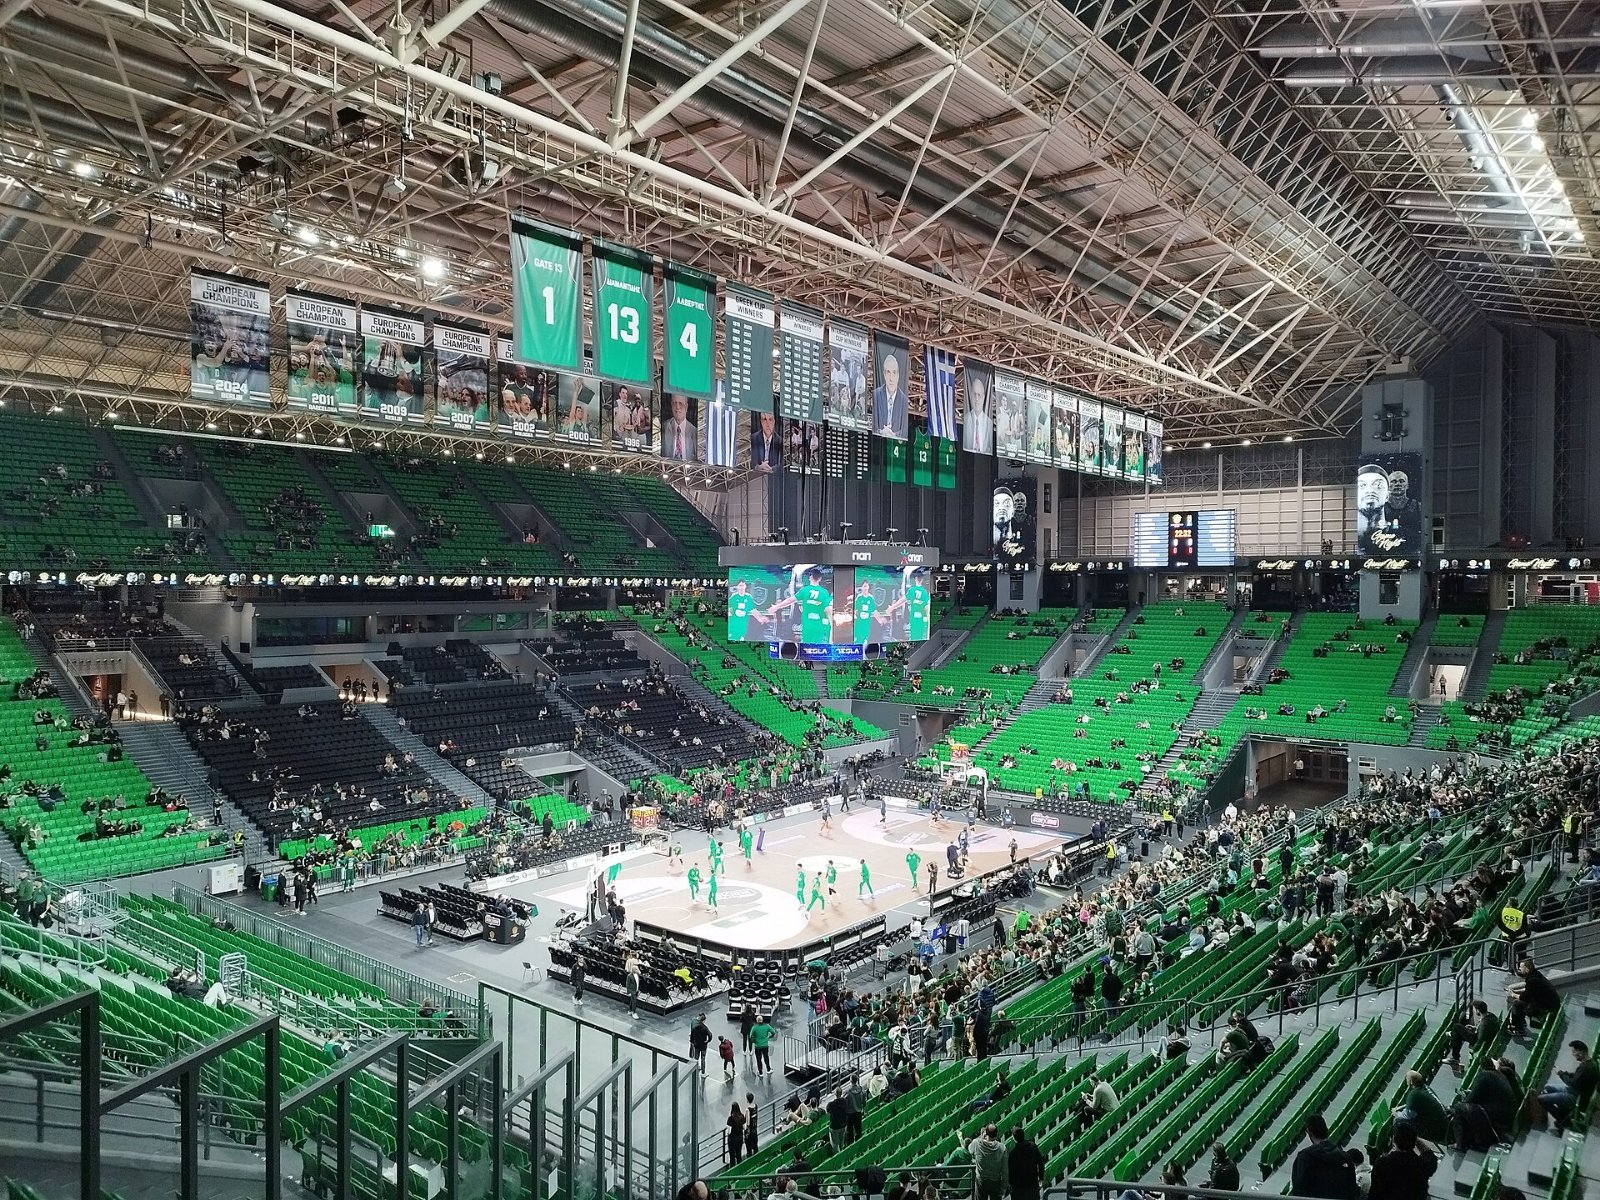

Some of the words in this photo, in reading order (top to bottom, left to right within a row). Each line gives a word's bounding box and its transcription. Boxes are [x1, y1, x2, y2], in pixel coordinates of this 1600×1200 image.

[534, 258, 554, 271] GATE
[554, 263, 563, 274] 13
[206, 282, 256, 300] EUROPEAN
[202, 292, 259, 310] CHAMPIONS
[542, 286, 554, 326] 1
[736, 296, 754, 307] GREEK
[754, 302, 766, 310] CUP
[300, 302, 343, 316] EUROPEAN
[738, 305, 764, 319] WINNERS
[296, 310, 347, 326] CHAMPIONS
[374, 318, 413, 332] EUROPEAN
[608, 302, 640, 344] 13
[370, 326, 416, 340] CHAMPIONS
[444, 331, 480, 345] EUROPEAN
[680, 322, 698, 358] 4
[442, 338, 483, 352] CHAMPIONS
[216, 380, 248, 394] 2024
[312, 393, 334, 406] 2011
[380, 404, 408, 416] 2009
[451, 412, 474, 424] 2007
[840, 416, 856, 428] 1996
[512, 422, 536, 432] 2002
[569, 430, 590, 442] 2000
[624, 437, 640, 448] 1996
[894, 446, 899, 458] 4
[919, 450, 927, 462] 13
[946, 454, 949, 466] 1
[1504, 914, 1518, 922] CSI
